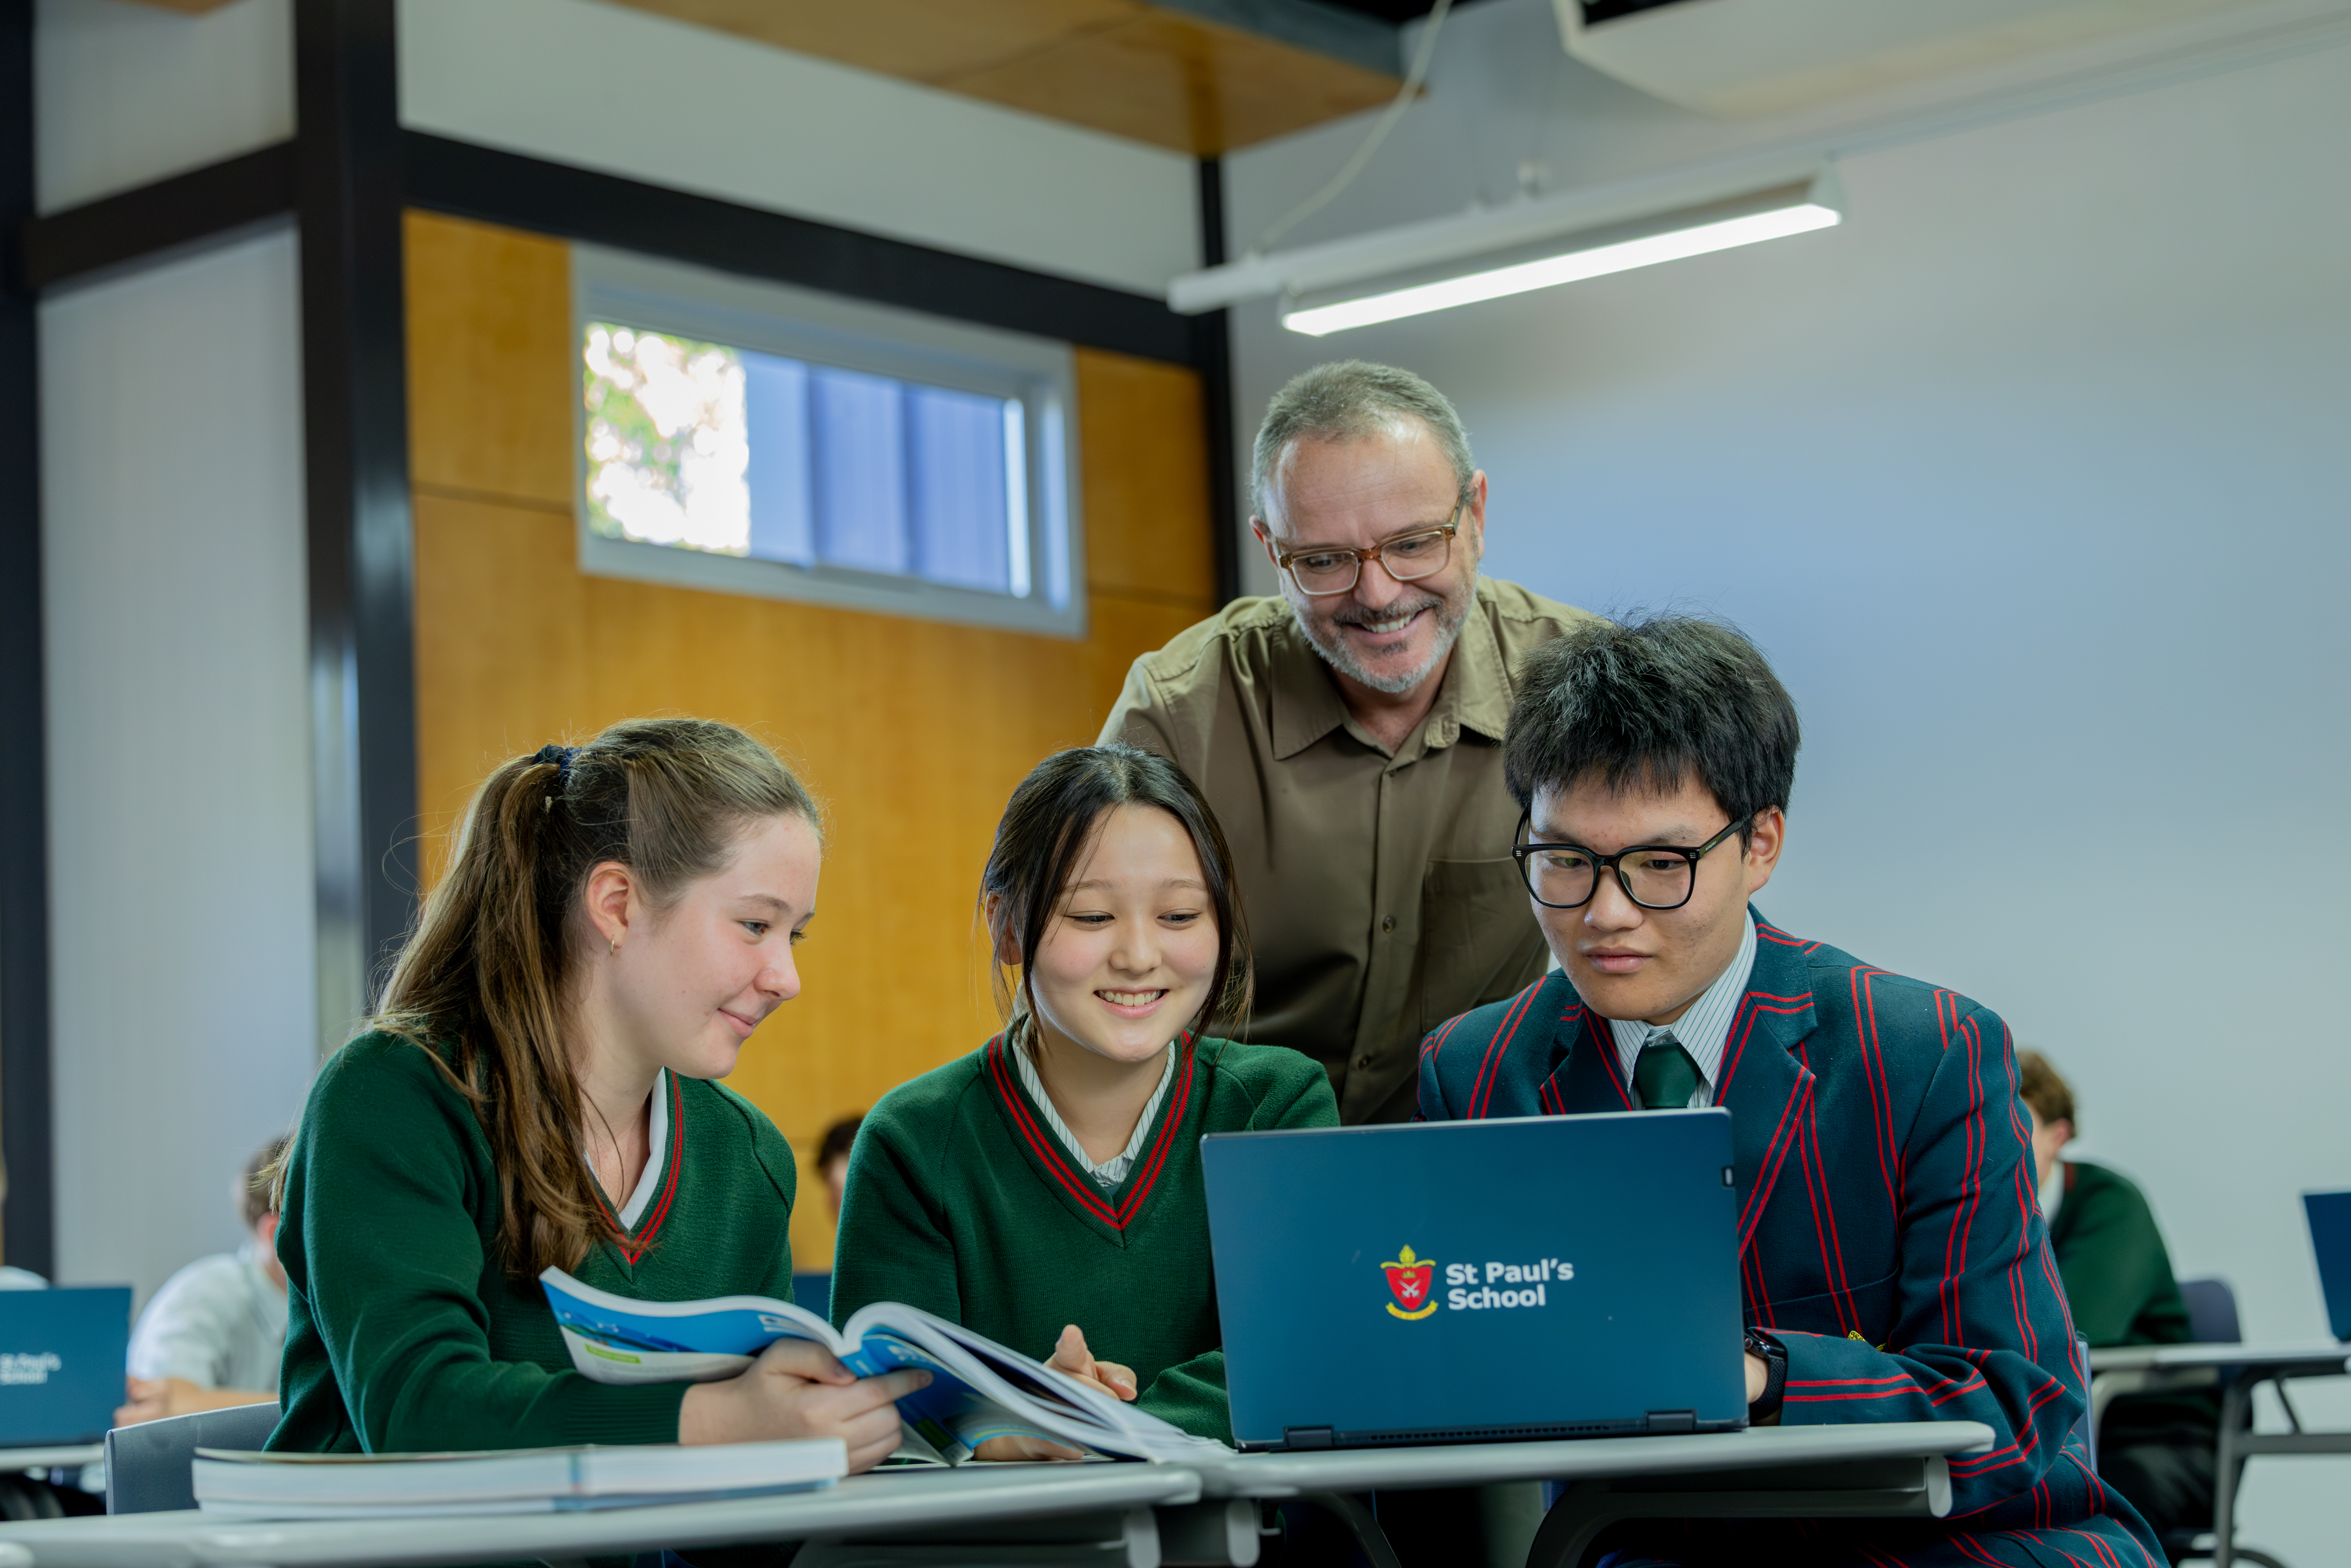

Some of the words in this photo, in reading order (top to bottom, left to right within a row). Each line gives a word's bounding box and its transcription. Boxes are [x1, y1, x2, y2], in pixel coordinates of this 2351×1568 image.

[1445, 1263, 1479, 1286] St
[1485, 1258, 1575, 1284] Paul's
[1447, 1283, 1547, 1311] School
